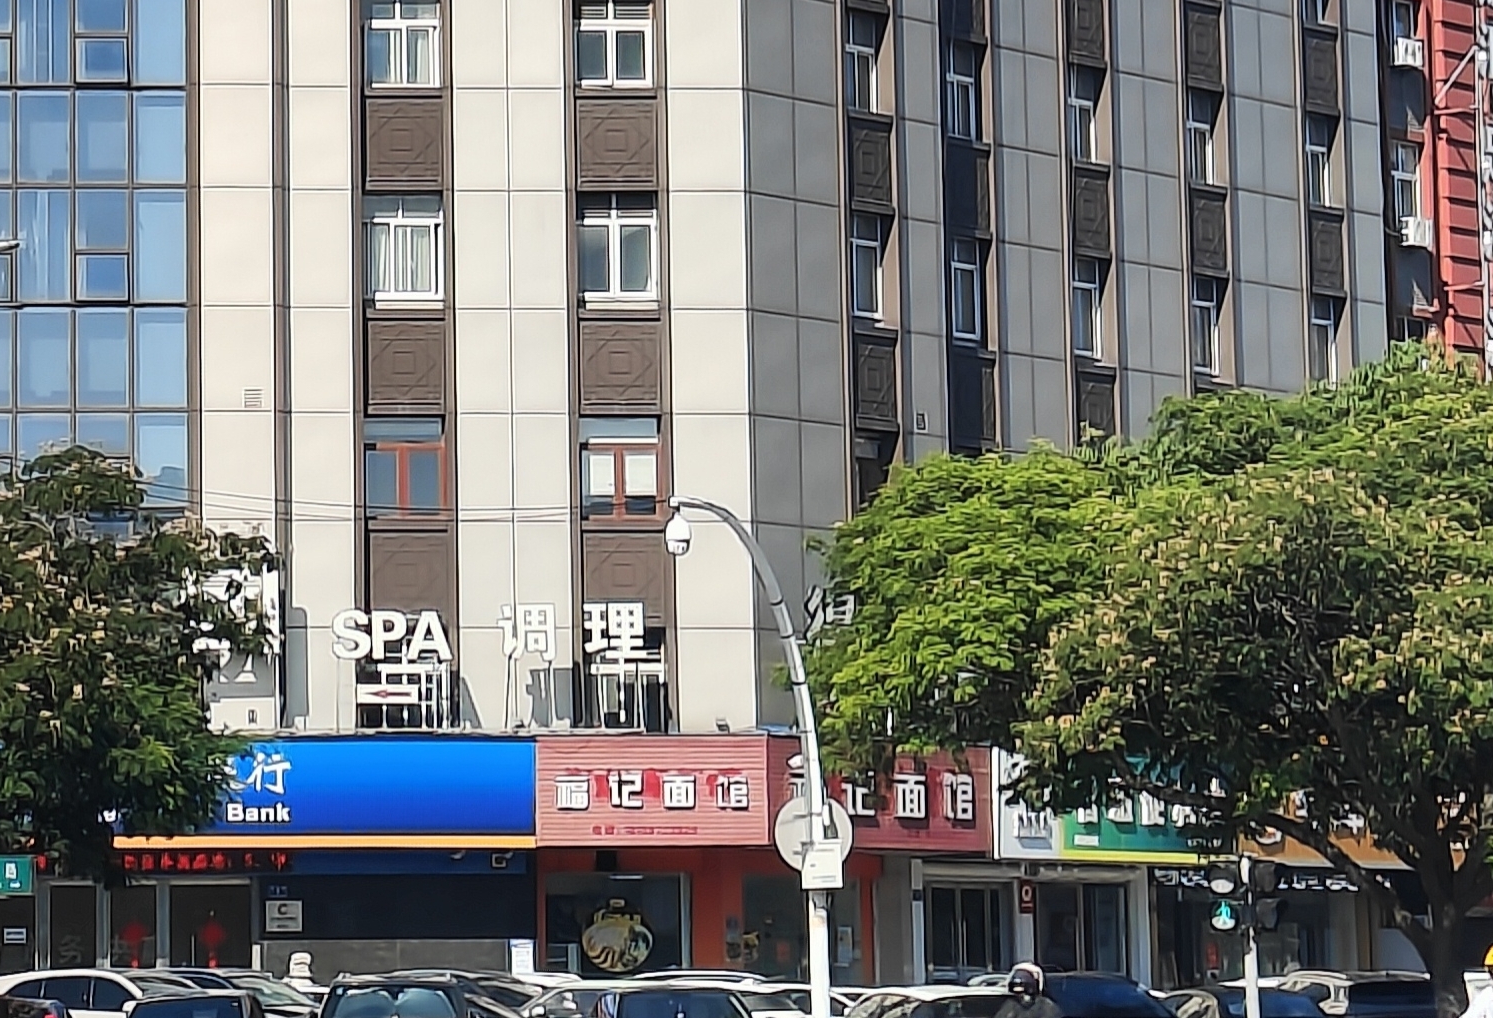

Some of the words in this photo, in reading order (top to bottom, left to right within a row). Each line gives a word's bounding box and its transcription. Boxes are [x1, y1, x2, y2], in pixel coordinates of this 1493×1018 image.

[332, 609, 454, 661] SPA
[496, 601, 645, 662] 调理
[226, 802, 291, 822] Bank
